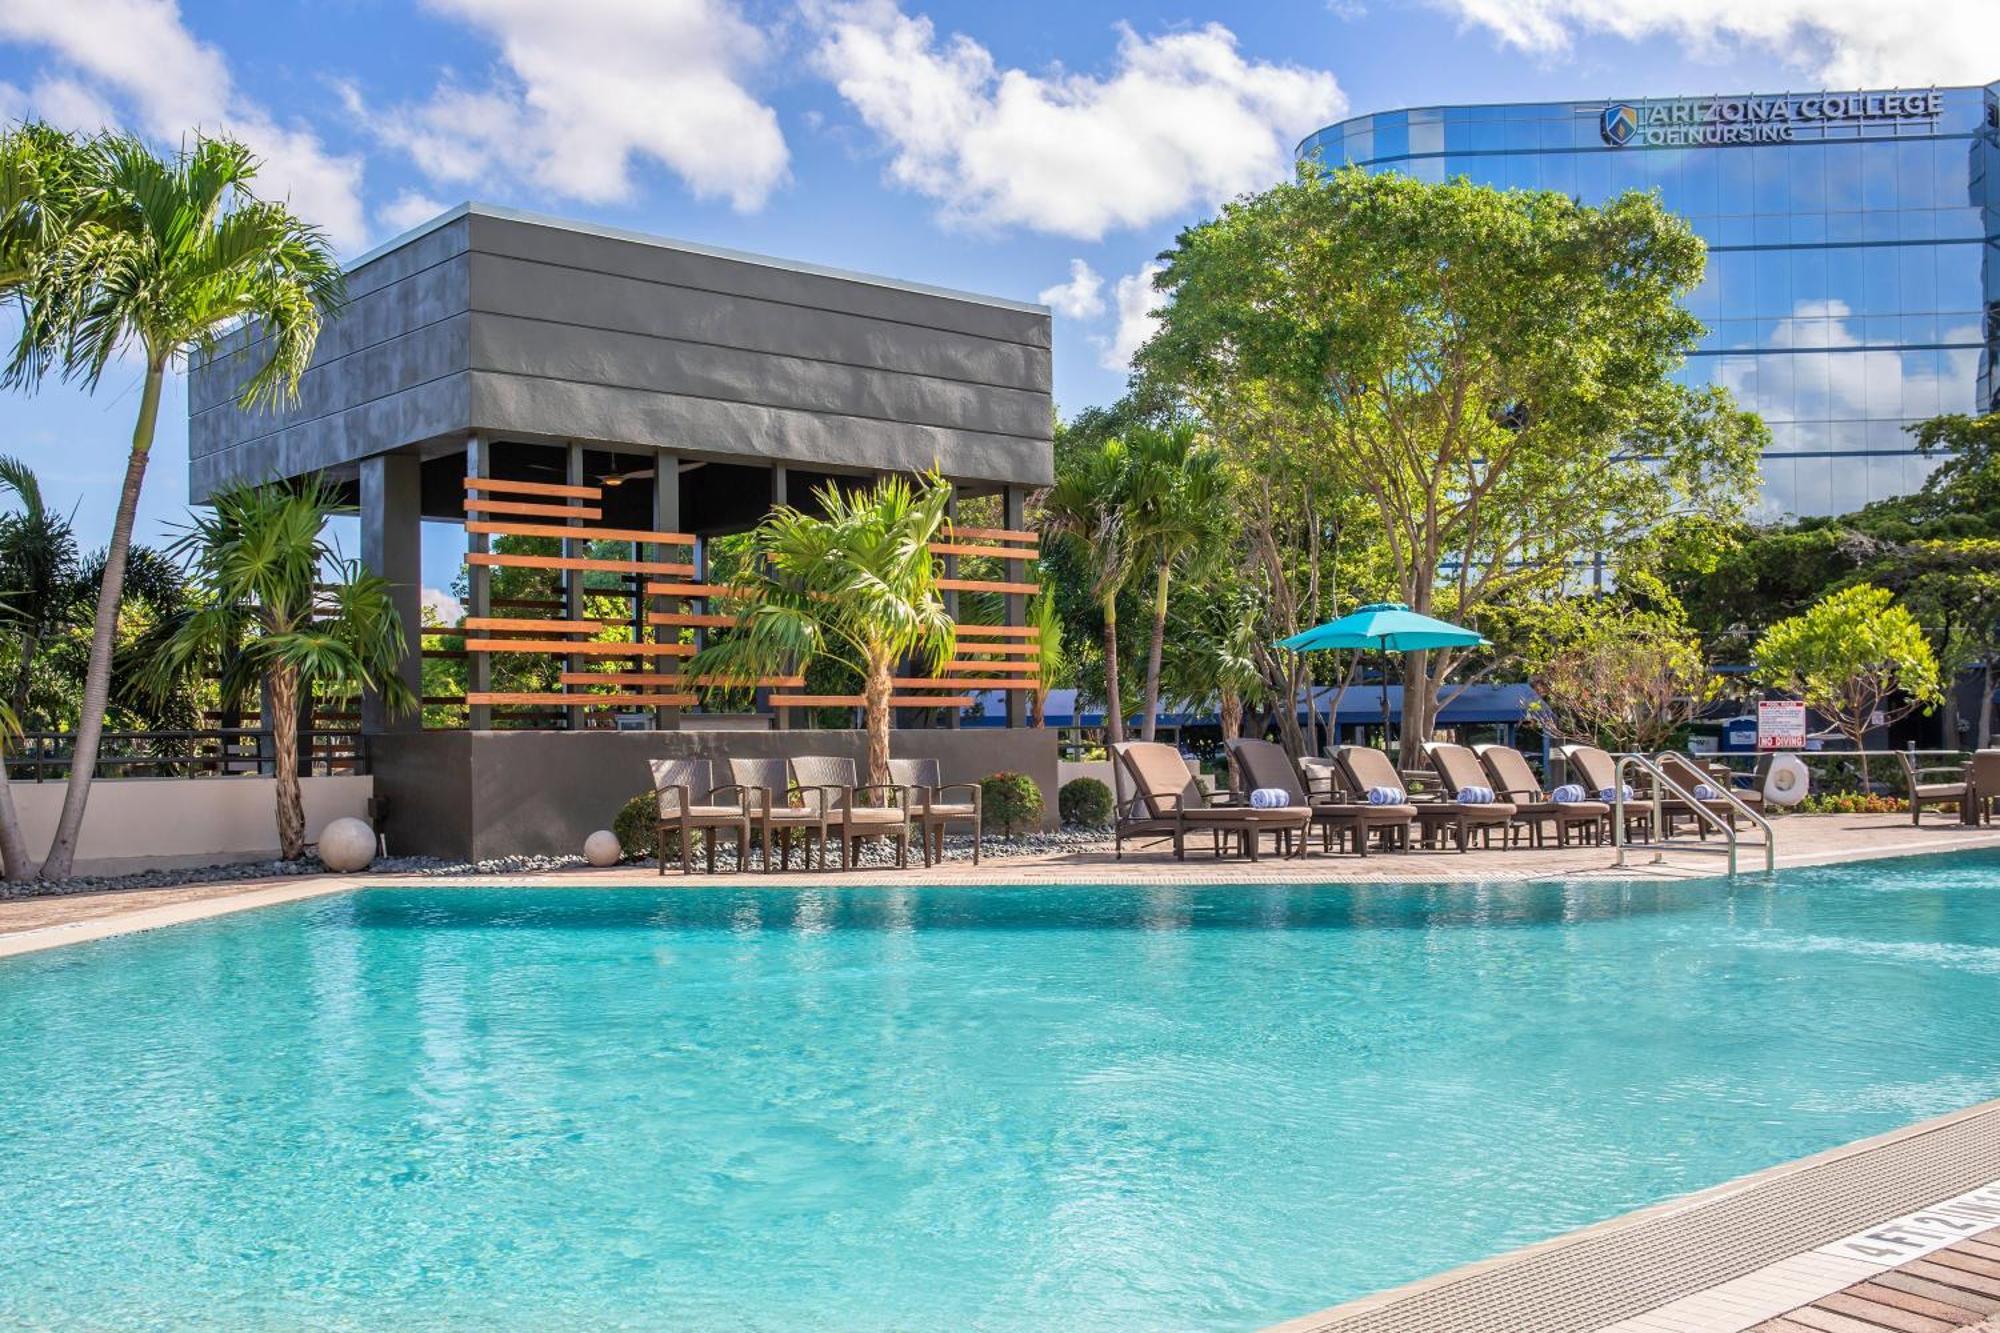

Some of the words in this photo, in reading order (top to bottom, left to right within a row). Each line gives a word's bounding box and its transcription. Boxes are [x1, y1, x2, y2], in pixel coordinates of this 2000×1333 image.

[1650, 99, 1789, 122] ARIZONA
[1801, 92, 1944, 118] COLLEGE
[1648, 127, 1679, 145] OF
[1689, 122, 1794, 144] NURSING
[1761, 736, 1773, 746] NO
[1775, 736, 1802, 746] DIVING
[1914, 1216, 1977, 1230] 2
[1864, 1226, 1947, 1249] FT
[1844, 1243, 1905, 1257] 4
